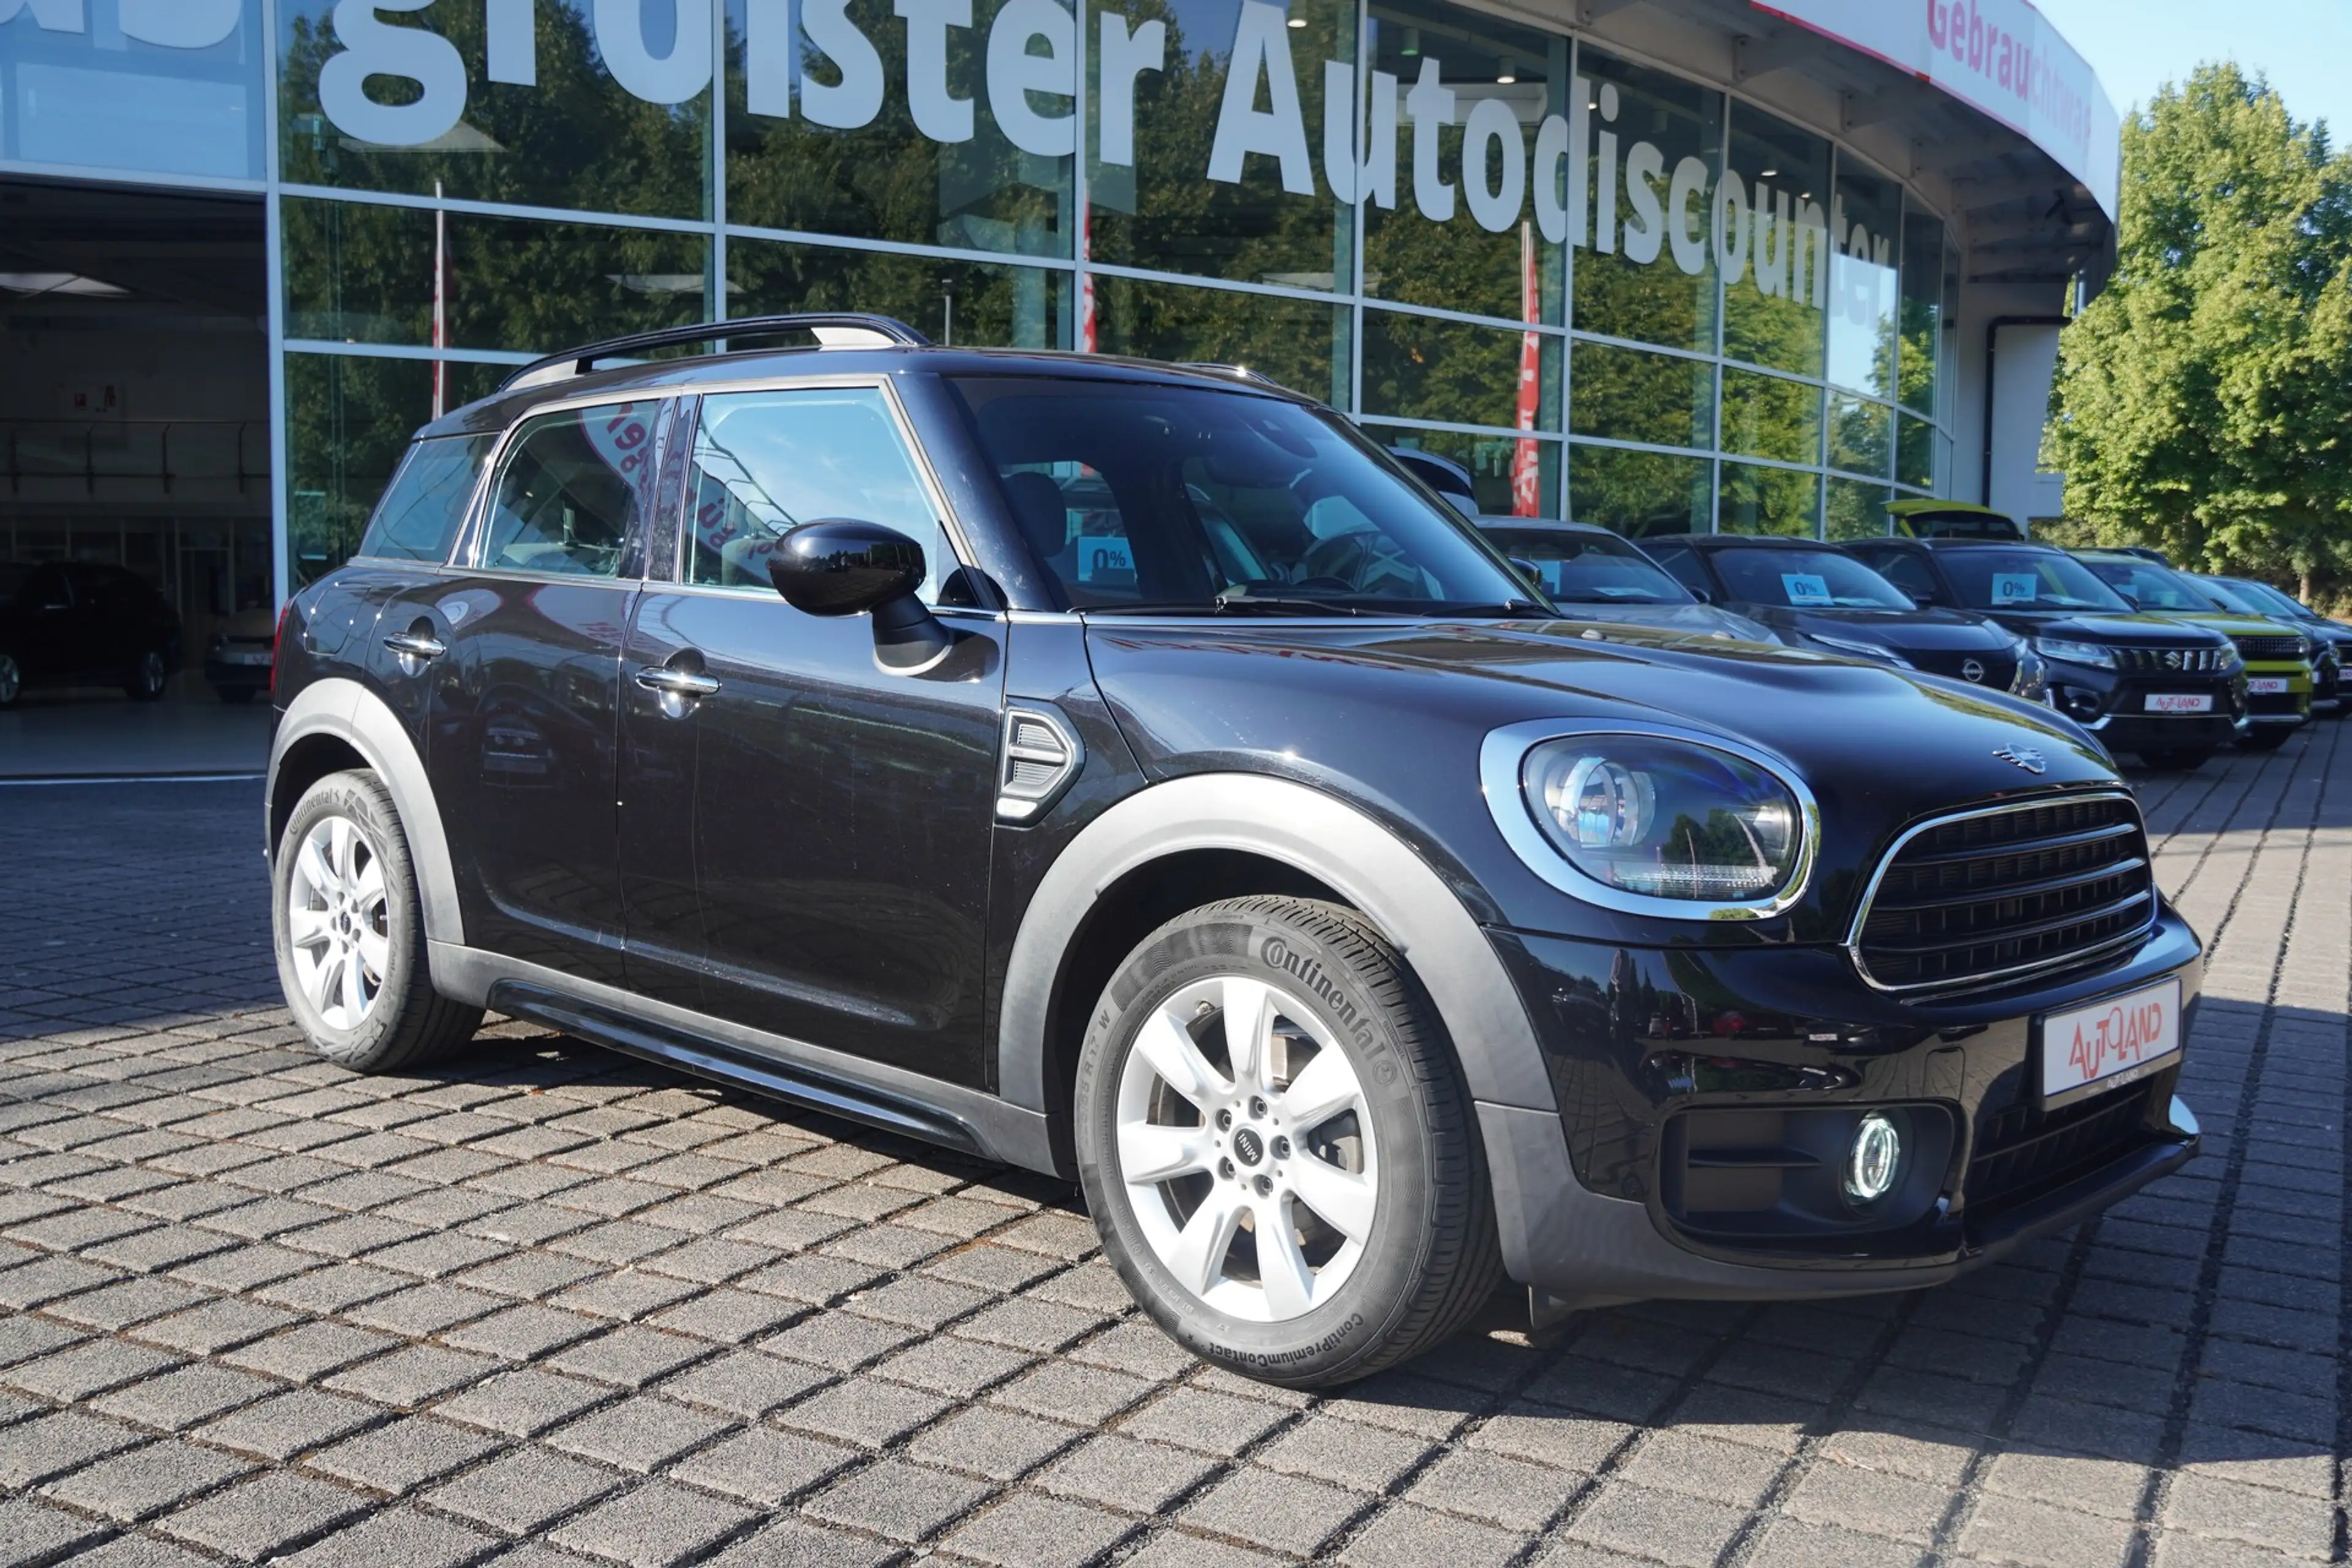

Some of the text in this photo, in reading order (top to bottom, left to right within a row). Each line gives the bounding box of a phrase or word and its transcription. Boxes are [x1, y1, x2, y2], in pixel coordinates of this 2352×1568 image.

[1206, 0, 1891, 331] Autodiscounter
[1093, 548, 1126, 569] 0%
[1795, 581, 1817, 595] 0%
[2002, 581, 2026, 597] 0%
[288, 787, 333, 835] Continental
[1260, 936, 1386, 1061] Continental
[1098, 1008, 1111, 1030] W
[2069, 1003, 2162, 1080] AUTOLAND
[1238, 1133, 1259, 1162] MINI
[1208, 1313, 1364, 1368] ContiPremiumContact
